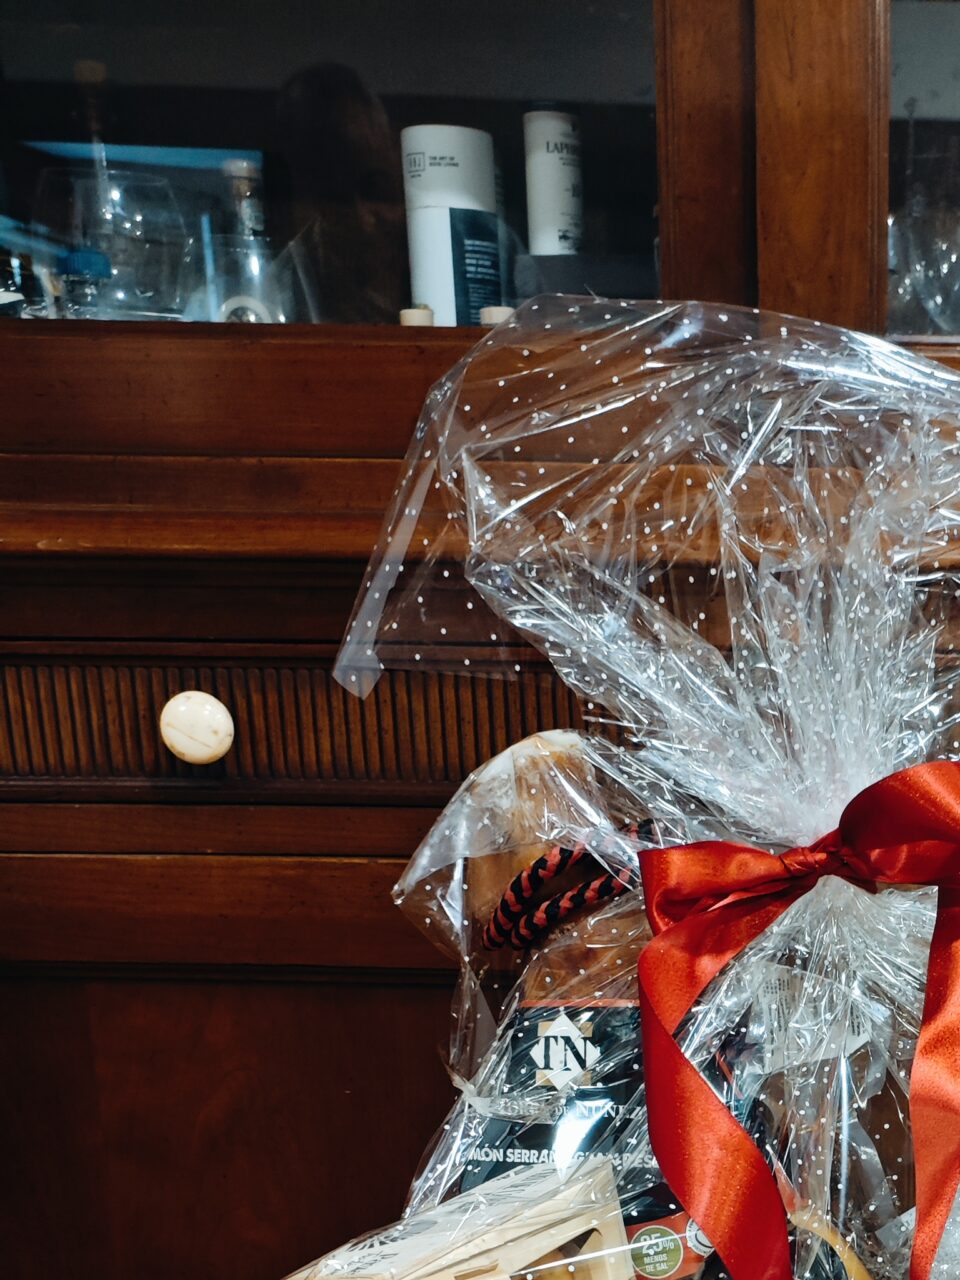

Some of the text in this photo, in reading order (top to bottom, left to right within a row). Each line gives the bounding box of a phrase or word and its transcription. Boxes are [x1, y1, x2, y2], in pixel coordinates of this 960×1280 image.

[541, 1035, 591, 1071] TN
[644, 1253, 668, 1264] MENOS
[645, 1262, 669, 1273] DE SAL
